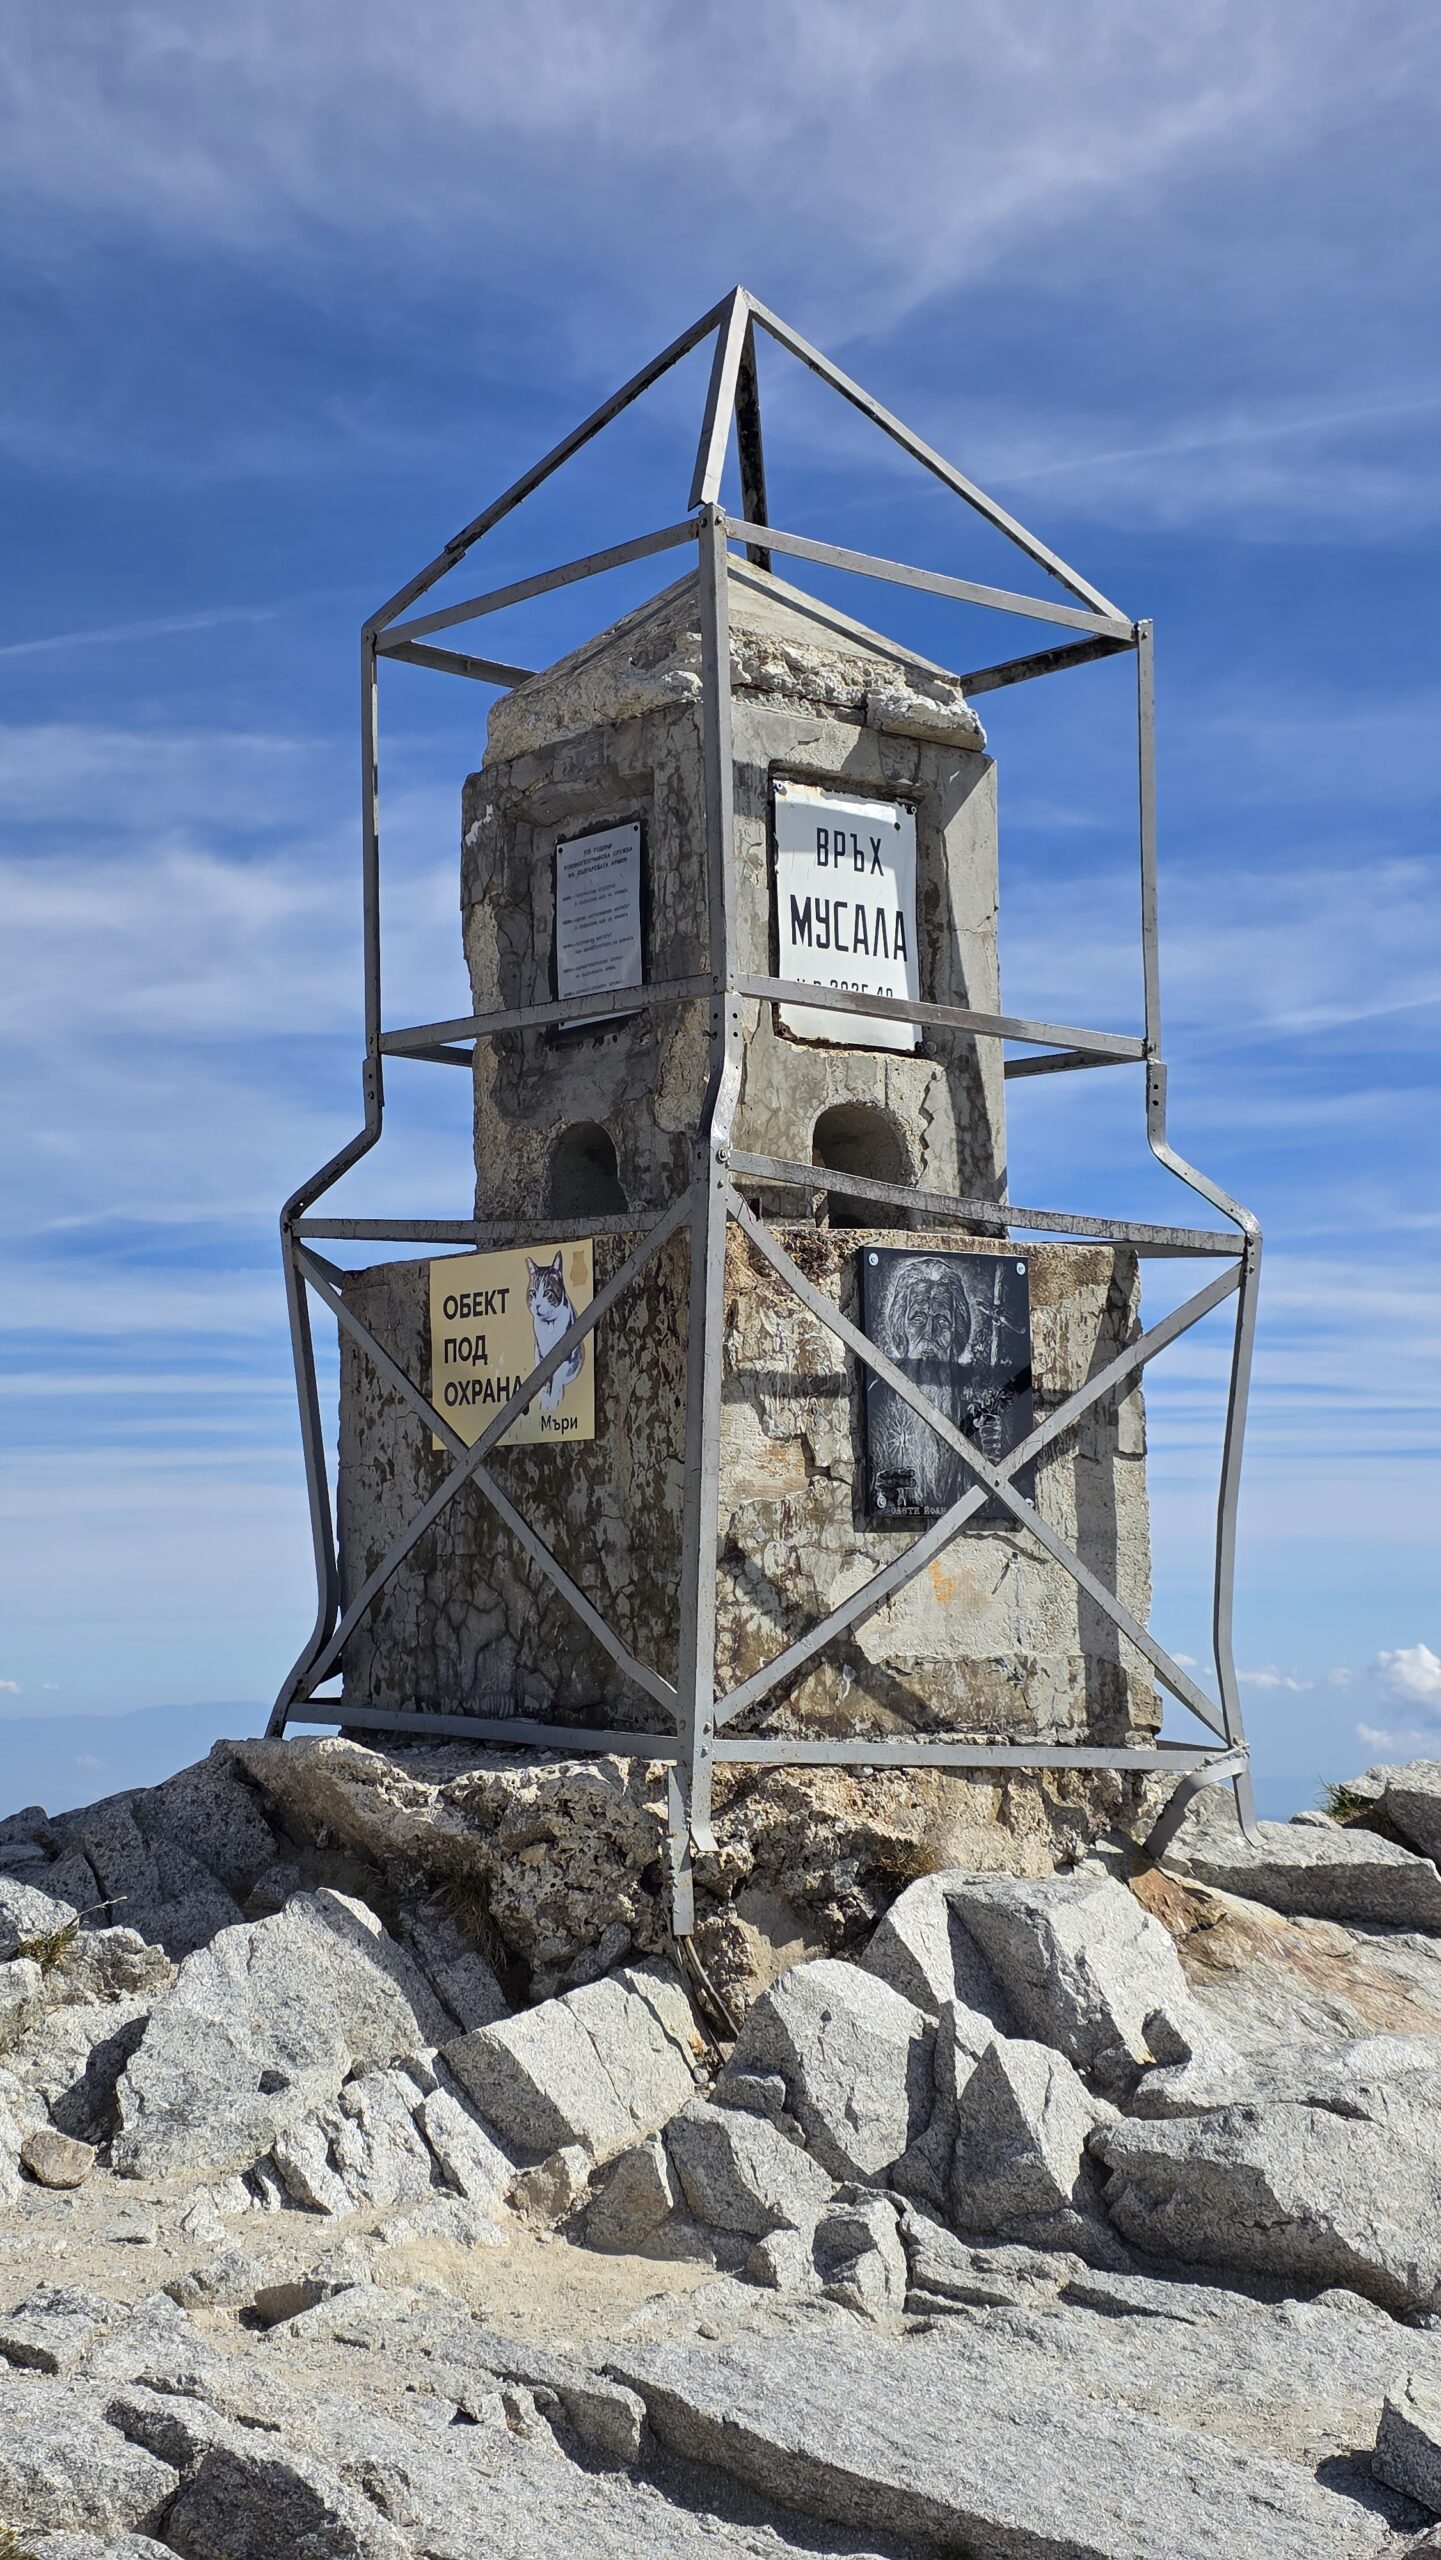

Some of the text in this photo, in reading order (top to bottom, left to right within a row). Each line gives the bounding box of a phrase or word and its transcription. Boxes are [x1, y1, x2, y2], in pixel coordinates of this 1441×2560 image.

[816, 827, 884, 876] ВРЪХ
[790, 894, 907, 962] МУСАЛА
[443, 1288, 510, 1320] ОБЕКТ
[444, 1335, 488, 1366] ПОД
[541, 1415, 578, 1434] Мъри
